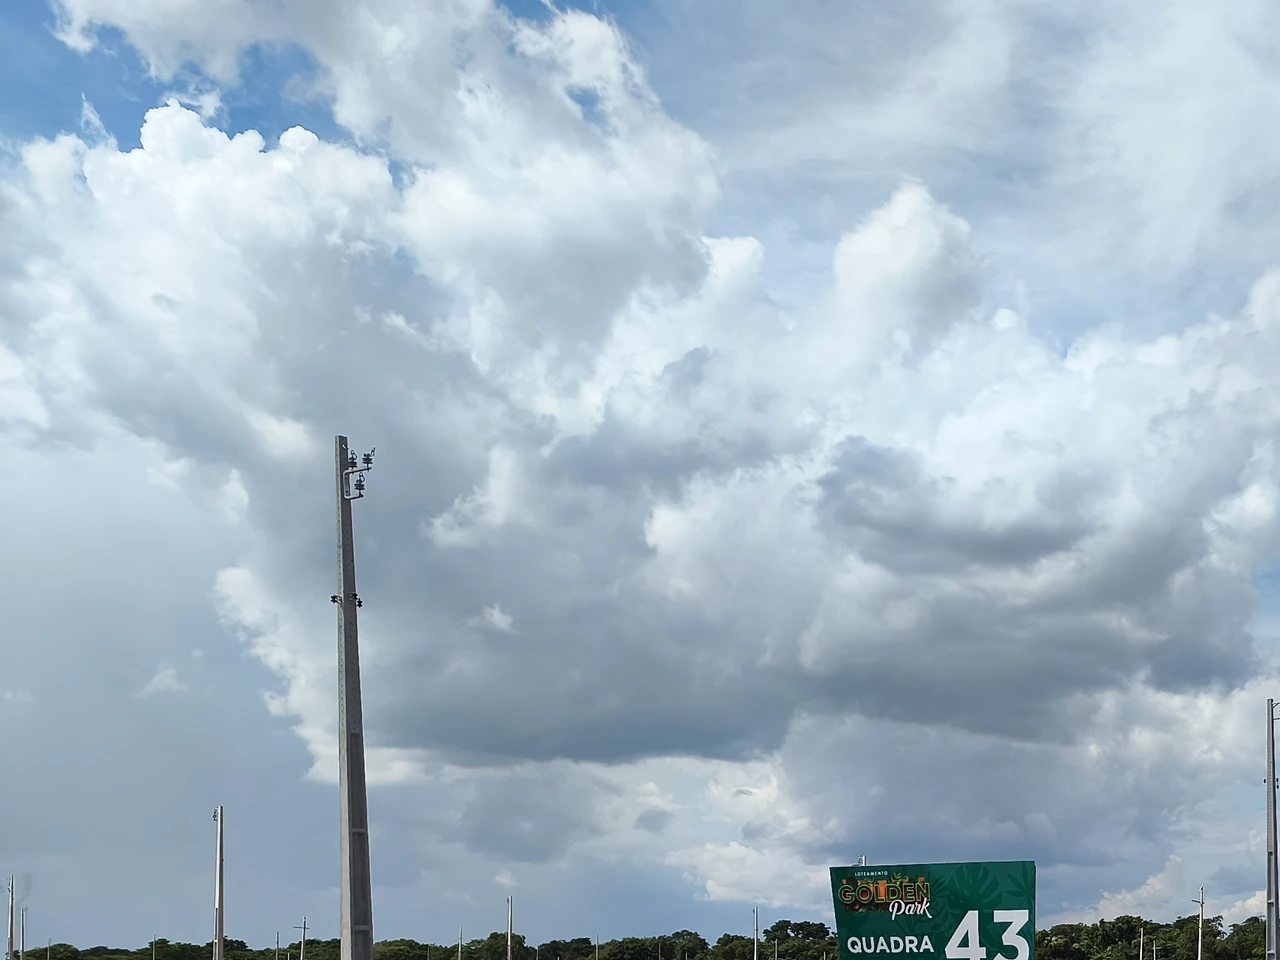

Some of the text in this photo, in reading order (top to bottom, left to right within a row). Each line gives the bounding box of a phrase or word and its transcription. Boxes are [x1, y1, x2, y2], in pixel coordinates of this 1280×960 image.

[838, 882, 931, 904] GOLDEN
[889, 897, 932, 921] Park
[846, 936, 935, 954] QUADRA
